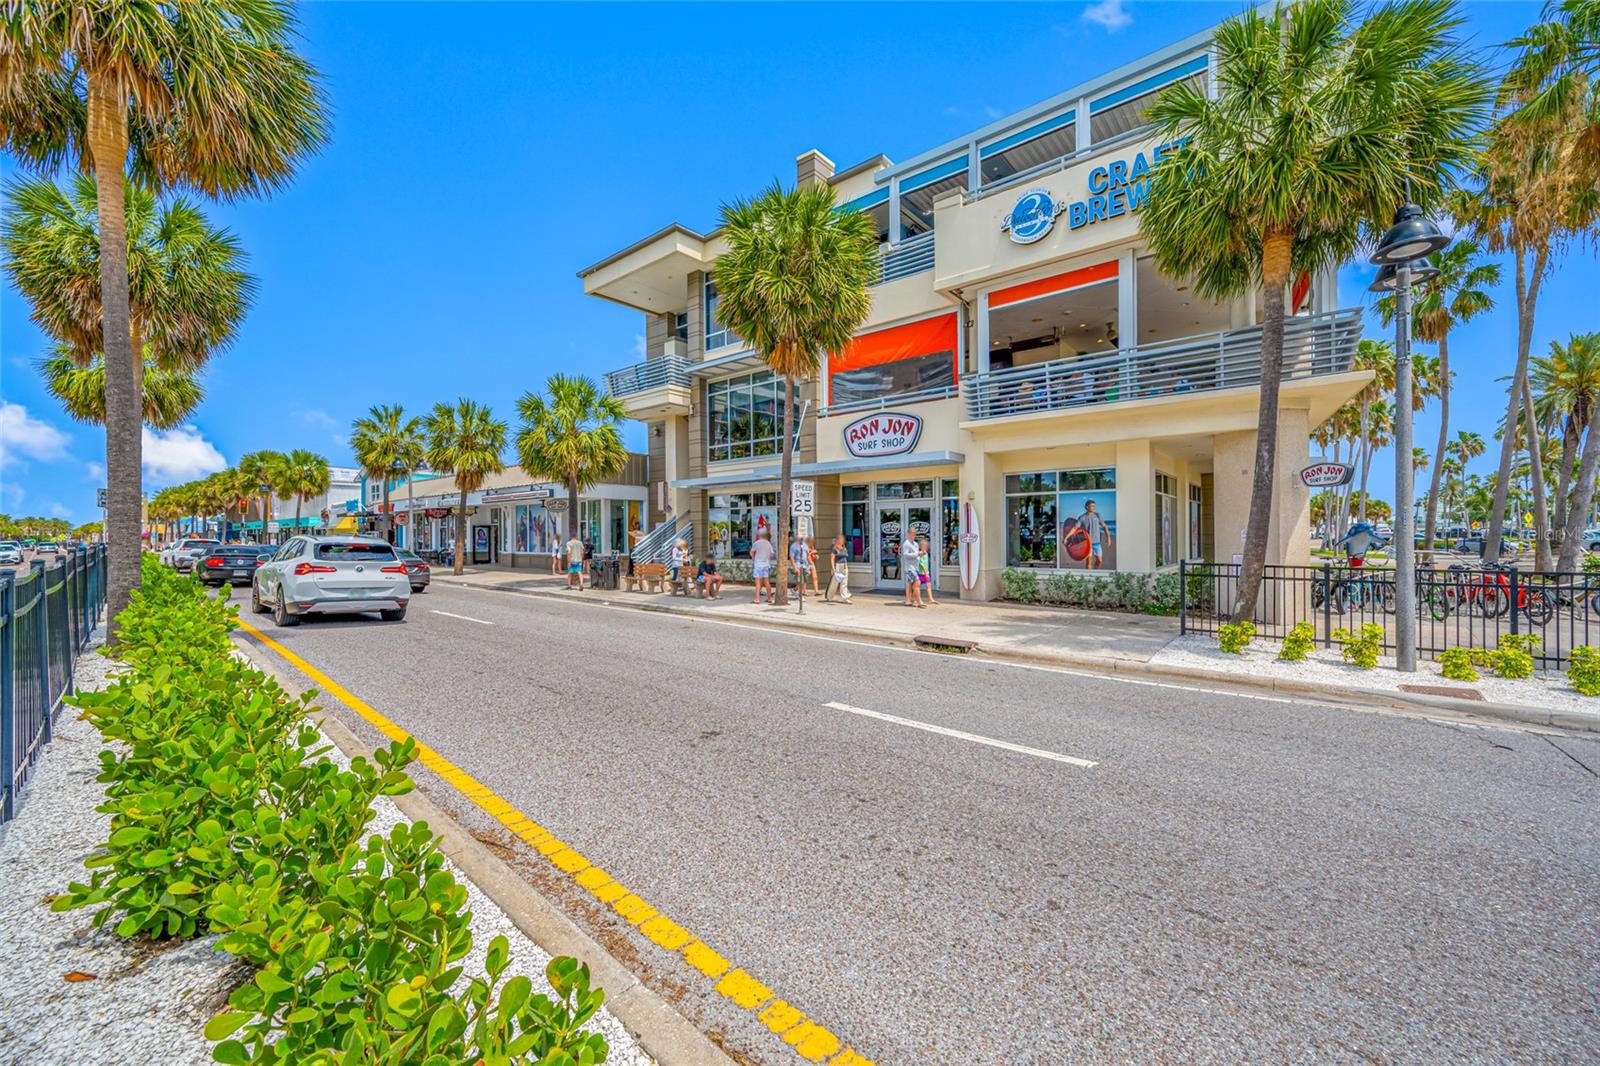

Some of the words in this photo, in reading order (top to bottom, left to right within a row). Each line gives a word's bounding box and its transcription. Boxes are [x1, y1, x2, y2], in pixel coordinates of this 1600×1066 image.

[850, 419, 880, 444] RON
[882, 418, 914, 436] JON
[858, 439, 878, 451] SURF
[881, 437, 905, 449] SHOP
[1304, 466, 1323, 480] RON
[1324, 466, 1344, 476] JON
[794, 484, 812, 492] SPEED
[794, 499, 812, 513] 25
